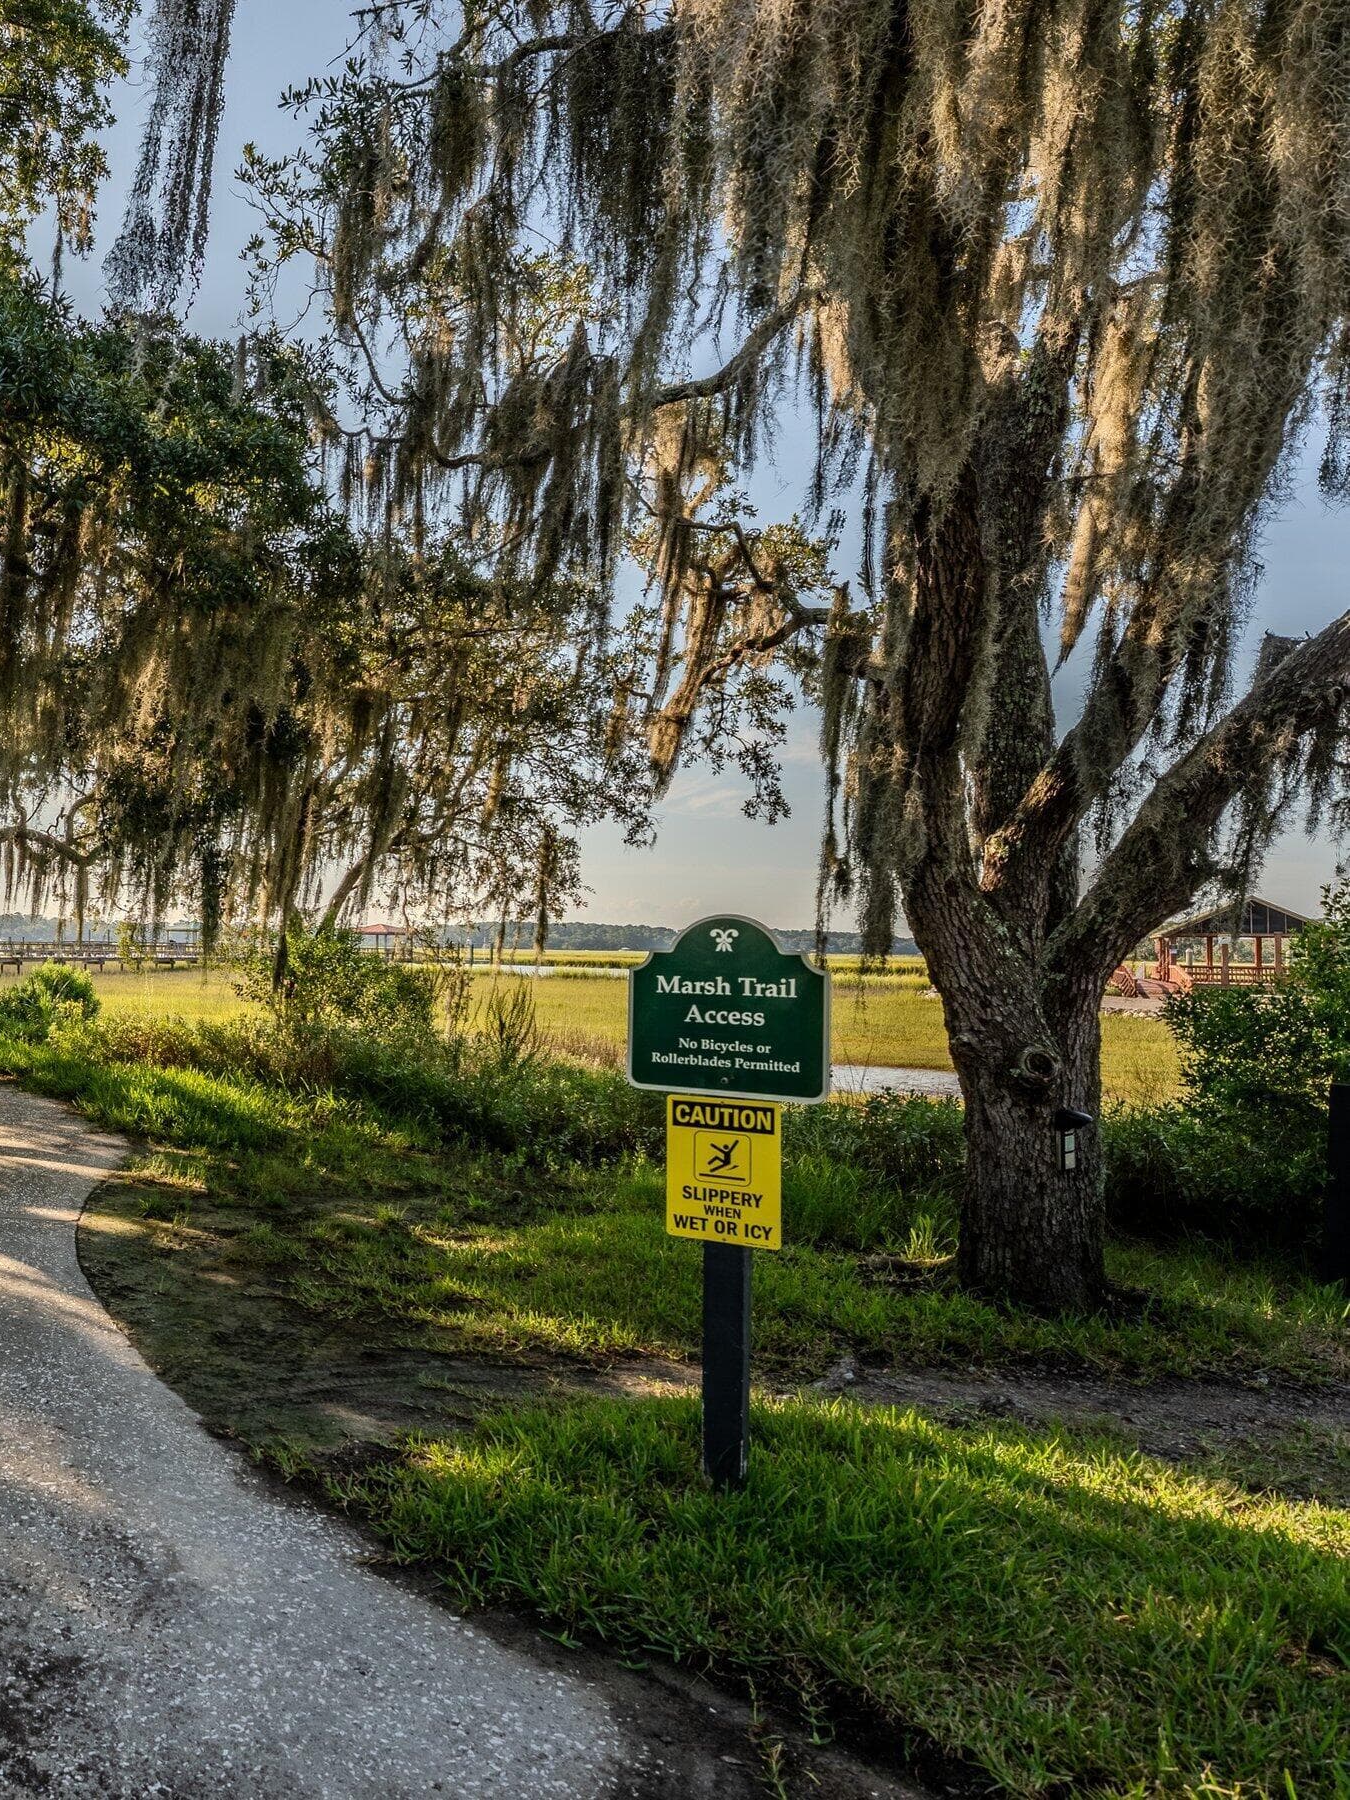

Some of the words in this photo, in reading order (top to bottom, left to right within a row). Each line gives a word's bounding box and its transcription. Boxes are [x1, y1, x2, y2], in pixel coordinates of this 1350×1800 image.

[656, 975, 731, 996] Marsh
[738, 977, 798, 998] Trail
[684, 1004, 765, 1026] Access
[678, 1037, 698, 1049] No
[701, 1039, 753, 1053] Bicycles
[756, 1043, 771, 1053] or
[651, 1052, 731, 1068] Rollerblades
[734, 1057, 800, 1073] Permitted
[675, 1104, 772, 1131] CAUTION
[682, 1185, 763, 1208] SLIPPERY
[704, 1205, 741, 1219] WHEN
[673, 1214, 708, 1232] WET
[714, 1220, 738, 1236] OR
[744, 1224, 773, 1241] ICY
